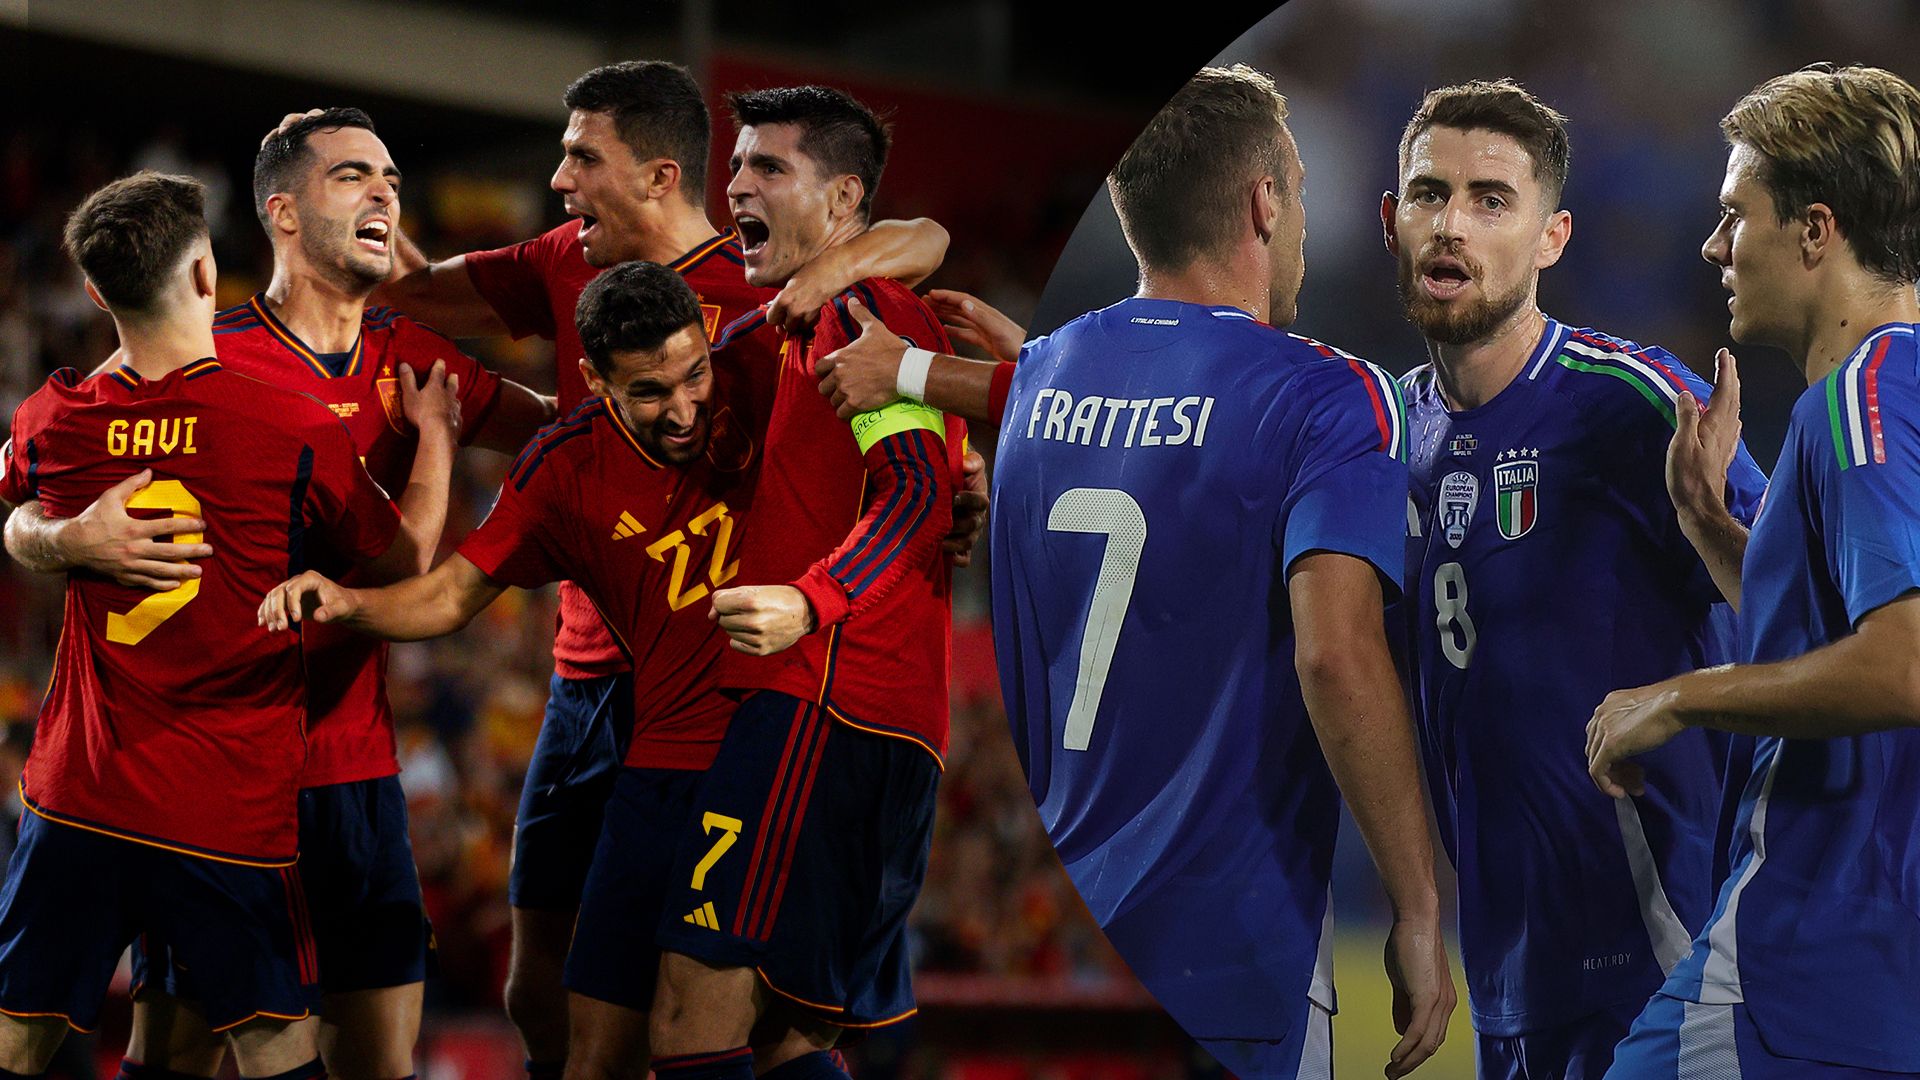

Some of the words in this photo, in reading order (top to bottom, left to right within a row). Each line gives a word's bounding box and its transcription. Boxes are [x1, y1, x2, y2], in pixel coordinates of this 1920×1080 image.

[107, 416, 197, 456] GAVI
[1027, 388, 1215, 447] FRATTESI
[1445, 484, 1475, 493] EUROPEAN
[1498, 466, 1534, 486] ITALIA
[645, 501, 741, 612] 22
[1047, 488, 1147, 751] 7
[1434, 562, 1477, 669] 8
[690, 811, 743, 891] 7
